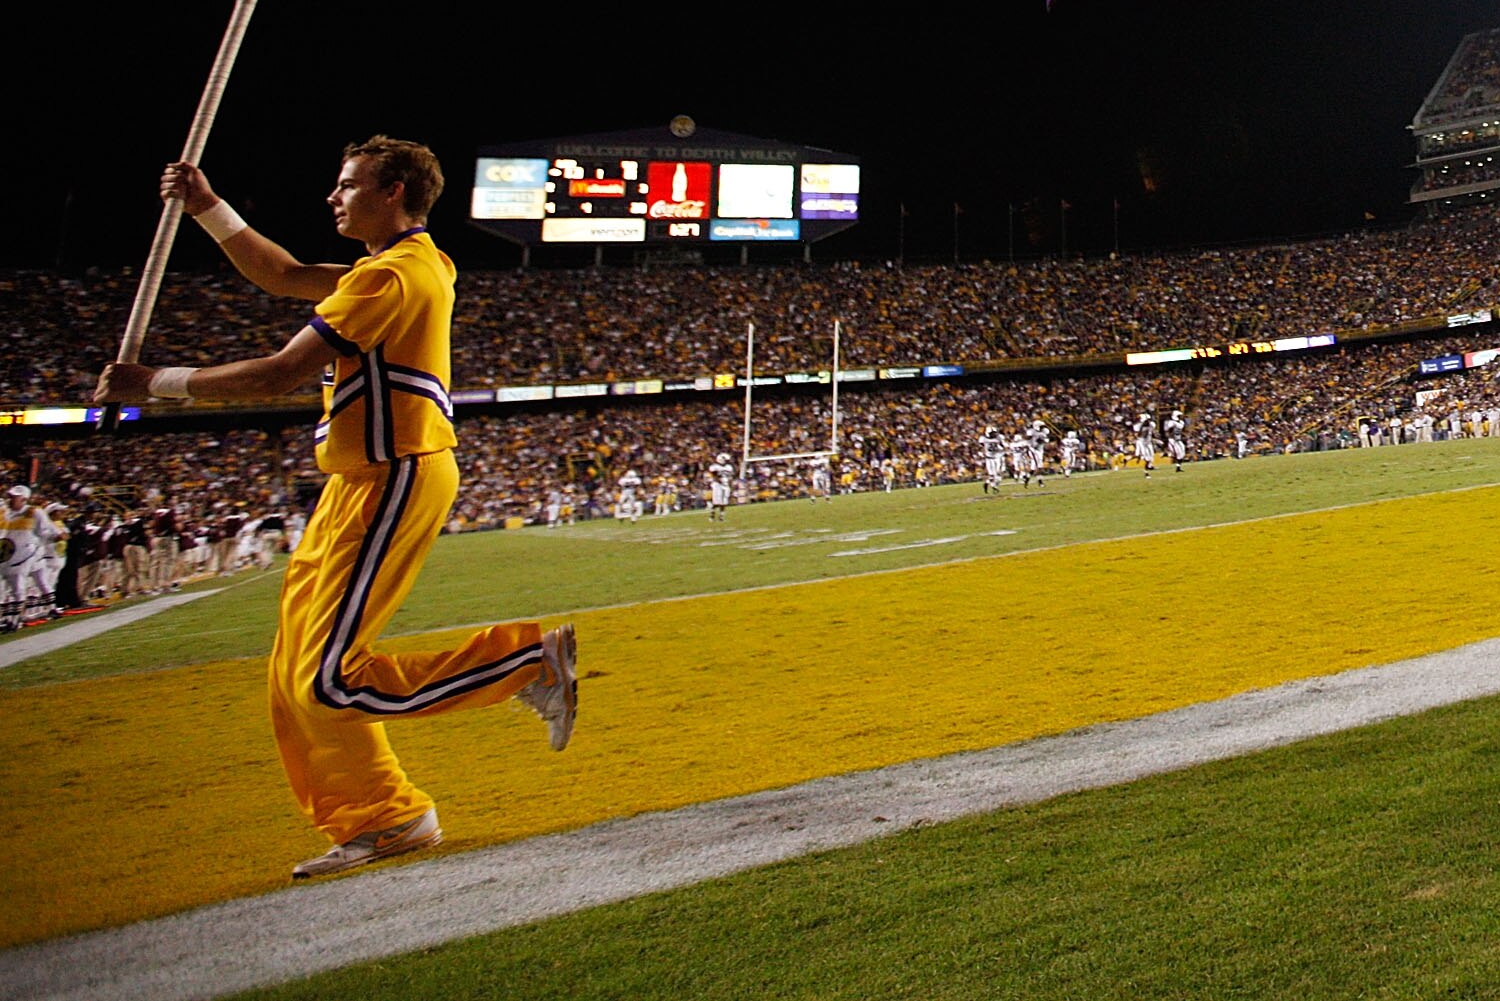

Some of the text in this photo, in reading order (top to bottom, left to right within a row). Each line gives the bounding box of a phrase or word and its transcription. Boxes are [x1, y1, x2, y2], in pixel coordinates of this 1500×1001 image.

[655, 147, 675, 159] TO
[681, 147, 736, 160] DEATH
[485, 165, 536, 183] COX
